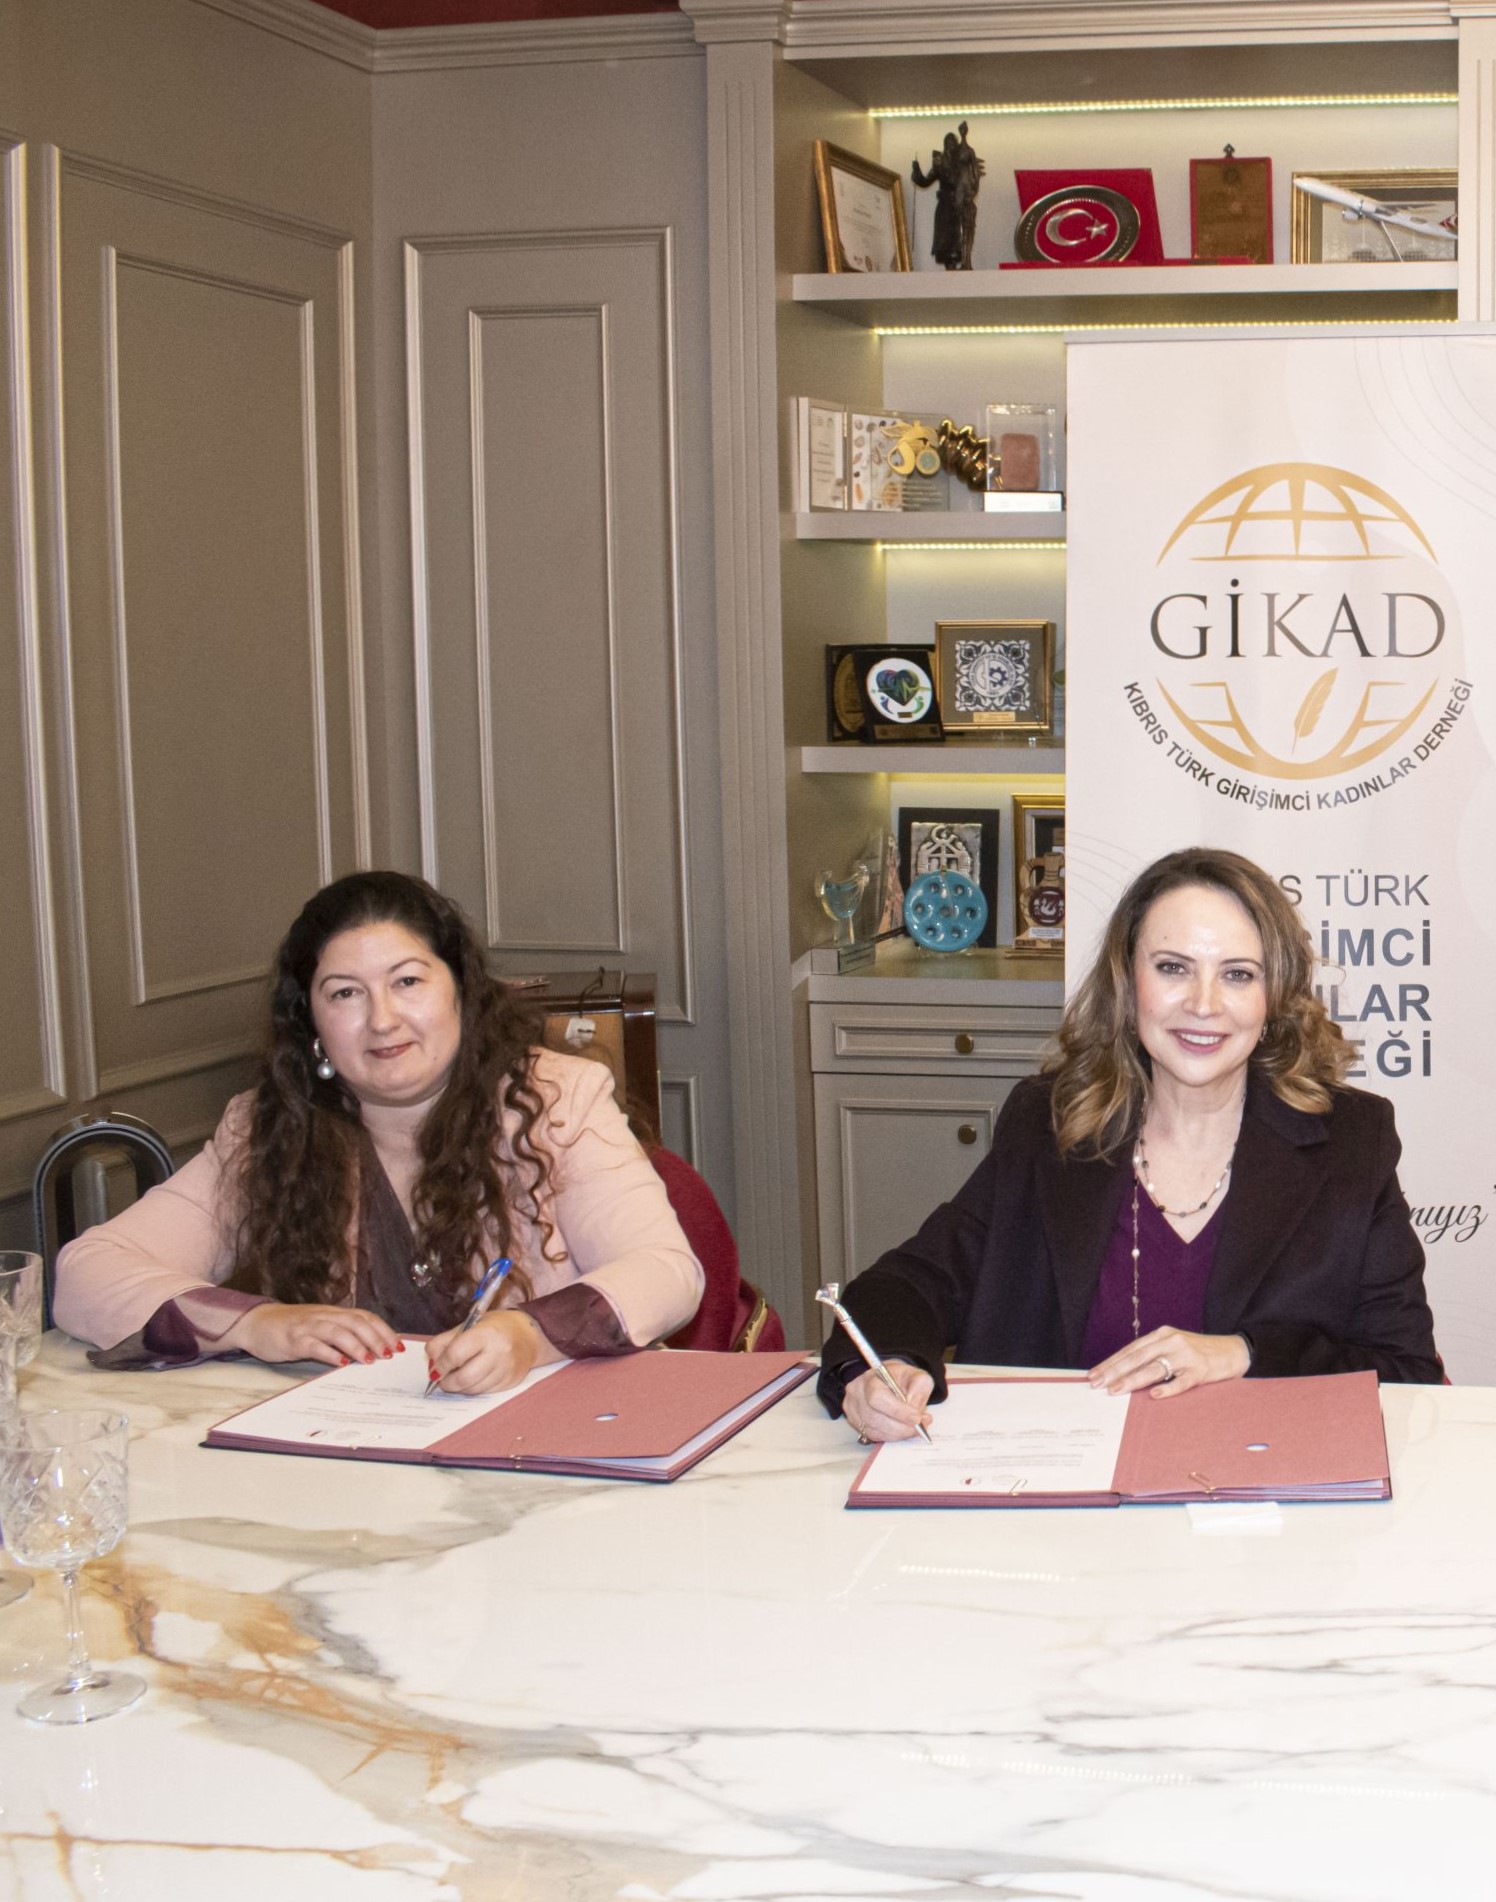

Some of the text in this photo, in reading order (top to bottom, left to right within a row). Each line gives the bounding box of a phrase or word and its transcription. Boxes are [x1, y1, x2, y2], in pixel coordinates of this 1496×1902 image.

[1150, 578, 1446, 660] GİKAD
[1123, 678, 1474, 811] KIBRIS TÜRK GİRİŞİMCİ KADINLAR DERNEĞİ
[1315, 868, 1430, 907] TÜRK
[1320, 919, 1431, 967] İMCİ
[1346, 1029, 1431, 1078] EĞİ
